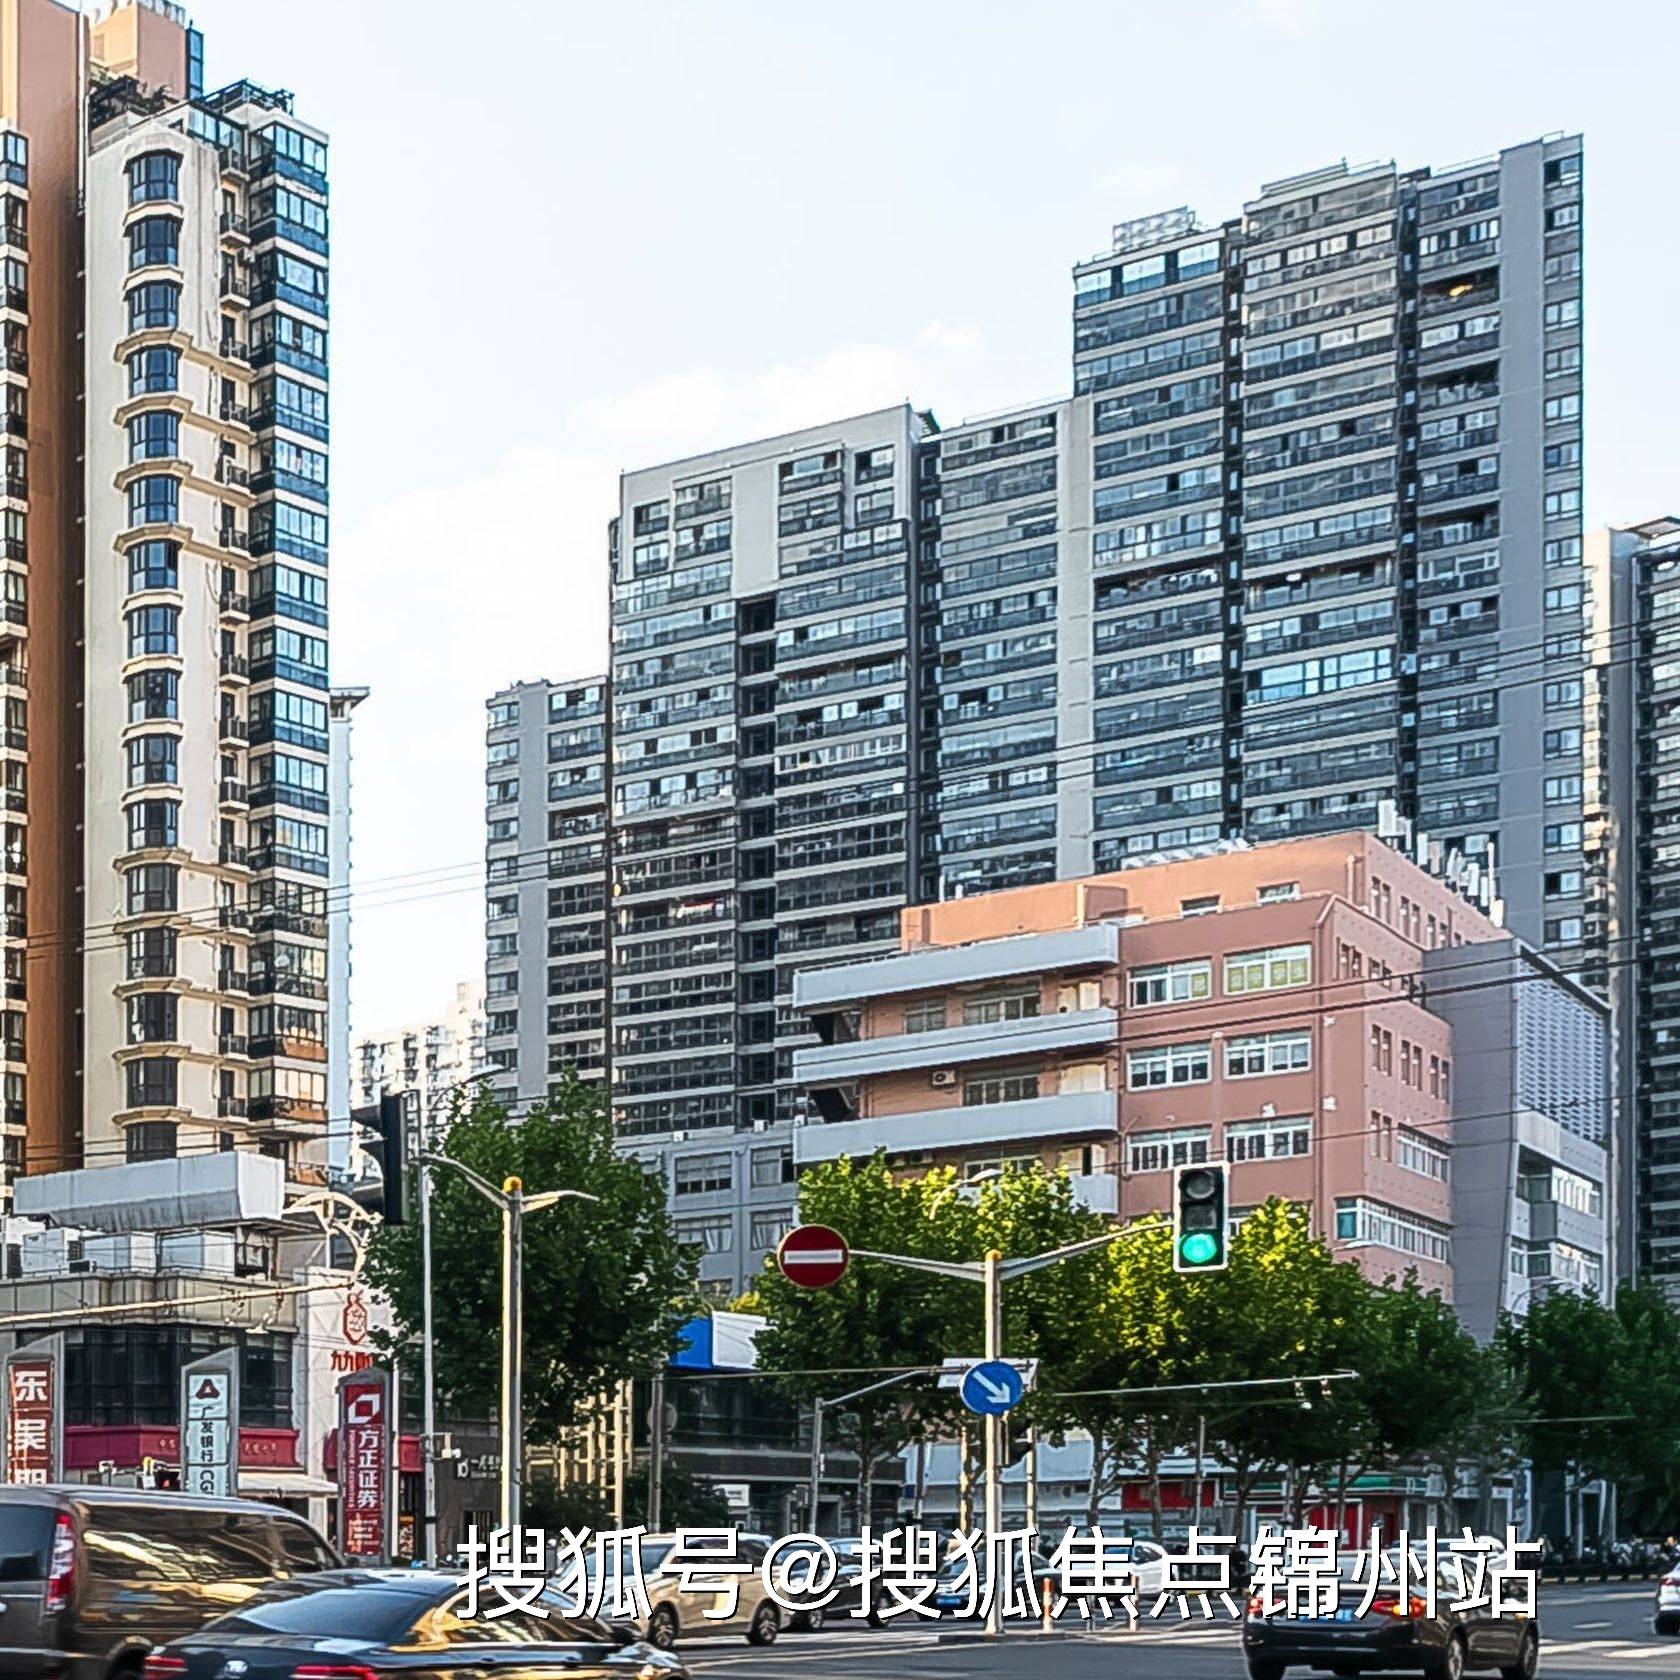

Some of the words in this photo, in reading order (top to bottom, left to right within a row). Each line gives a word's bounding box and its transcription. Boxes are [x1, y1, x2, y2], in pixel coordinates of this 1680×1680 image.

[200, 1406, 214, 1462] 广发银行
[200, 1470, 214, 1495] CG
[357, 1430, 380, 1508] 方正证券
